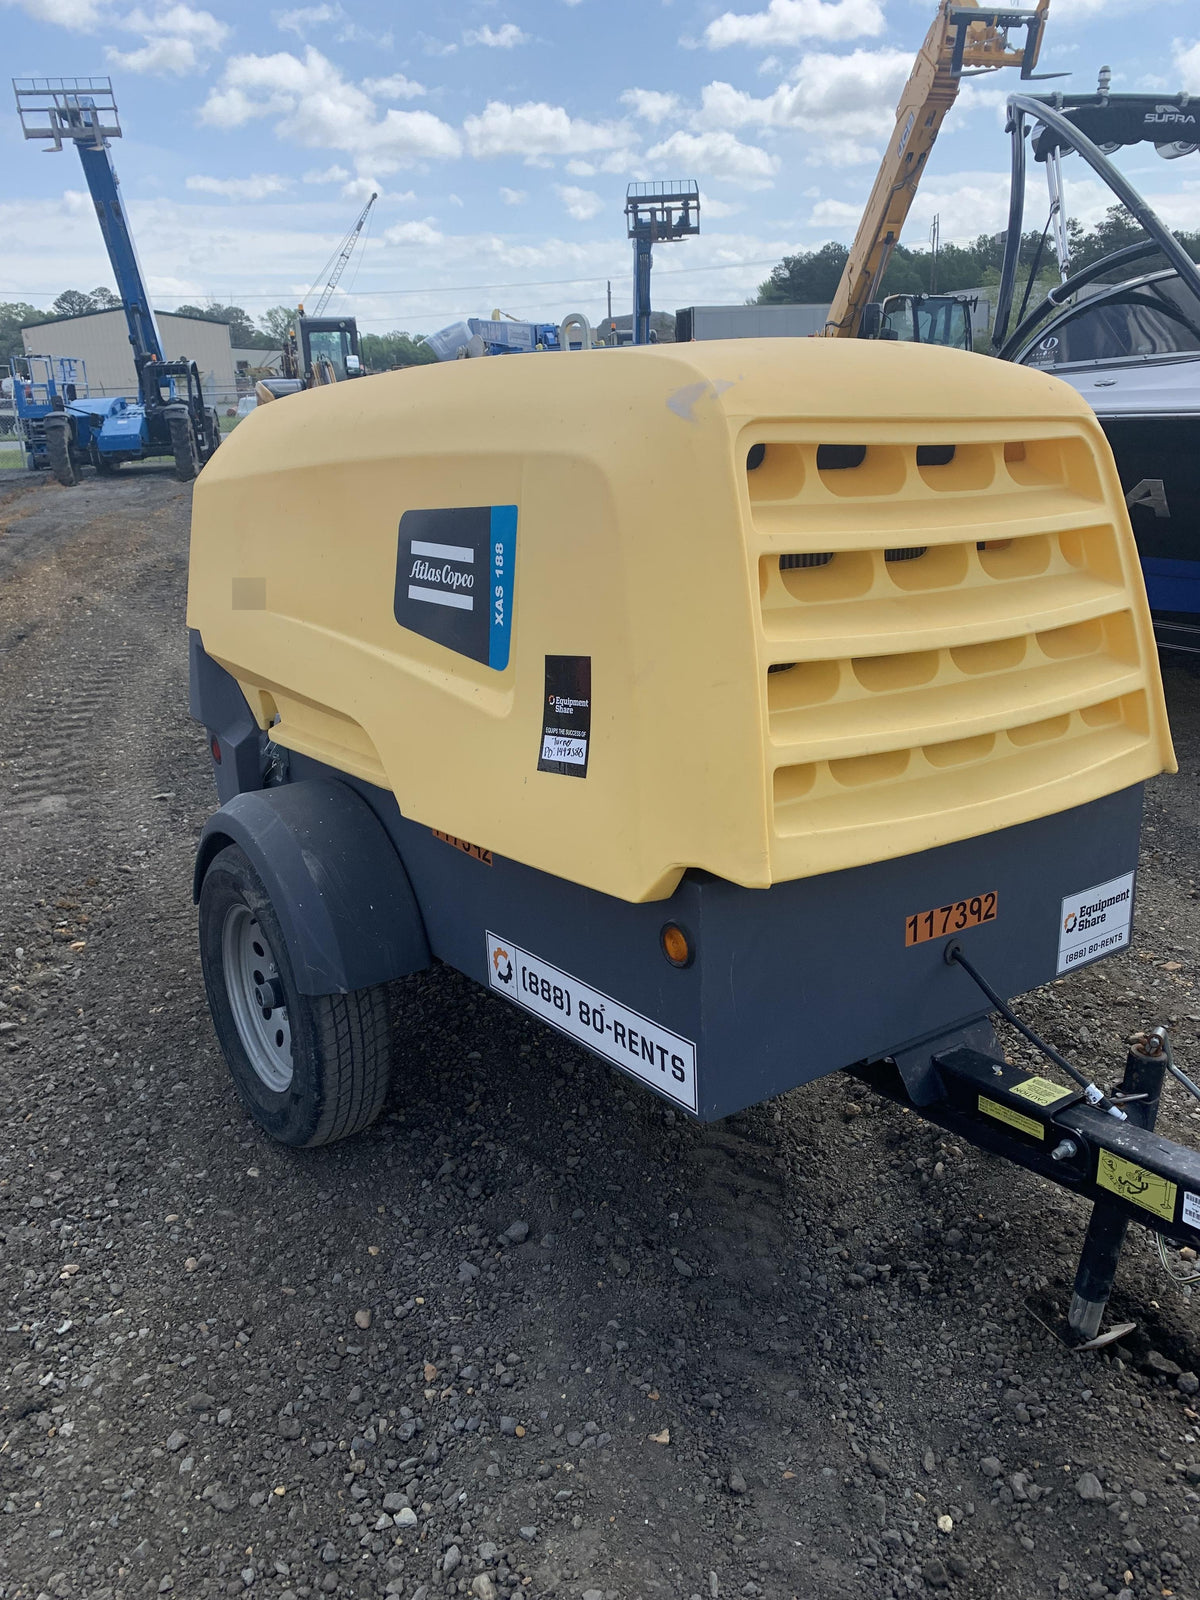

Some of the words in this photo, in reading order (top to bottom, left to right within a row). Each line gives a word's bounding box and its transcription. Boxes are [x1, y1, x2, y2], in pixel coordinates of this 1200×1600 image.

[1144, 113, 1196, 123] SUPRA
[409, 560, 441, 582] Atlas
[441, 564, 474, 589] Copco
[495, 542, 504, 578] 188
[495, 585, 504, 626] XAS
[555, 696, 589, 707] Equipment
[555, 705, 574, 714] Share
[908, 892, 996, 943] 117392
[1079, 888, 1130, 919] Equipment
[1078, 913, 1107, 932] Share
[1065, 947, 1087, 964] (888)
[1088, 932, 1123, 955] 80-RENTS
[521, 965, 571, 1017] (888)
[578, 1000, 686, 1083] 80-RENTS
